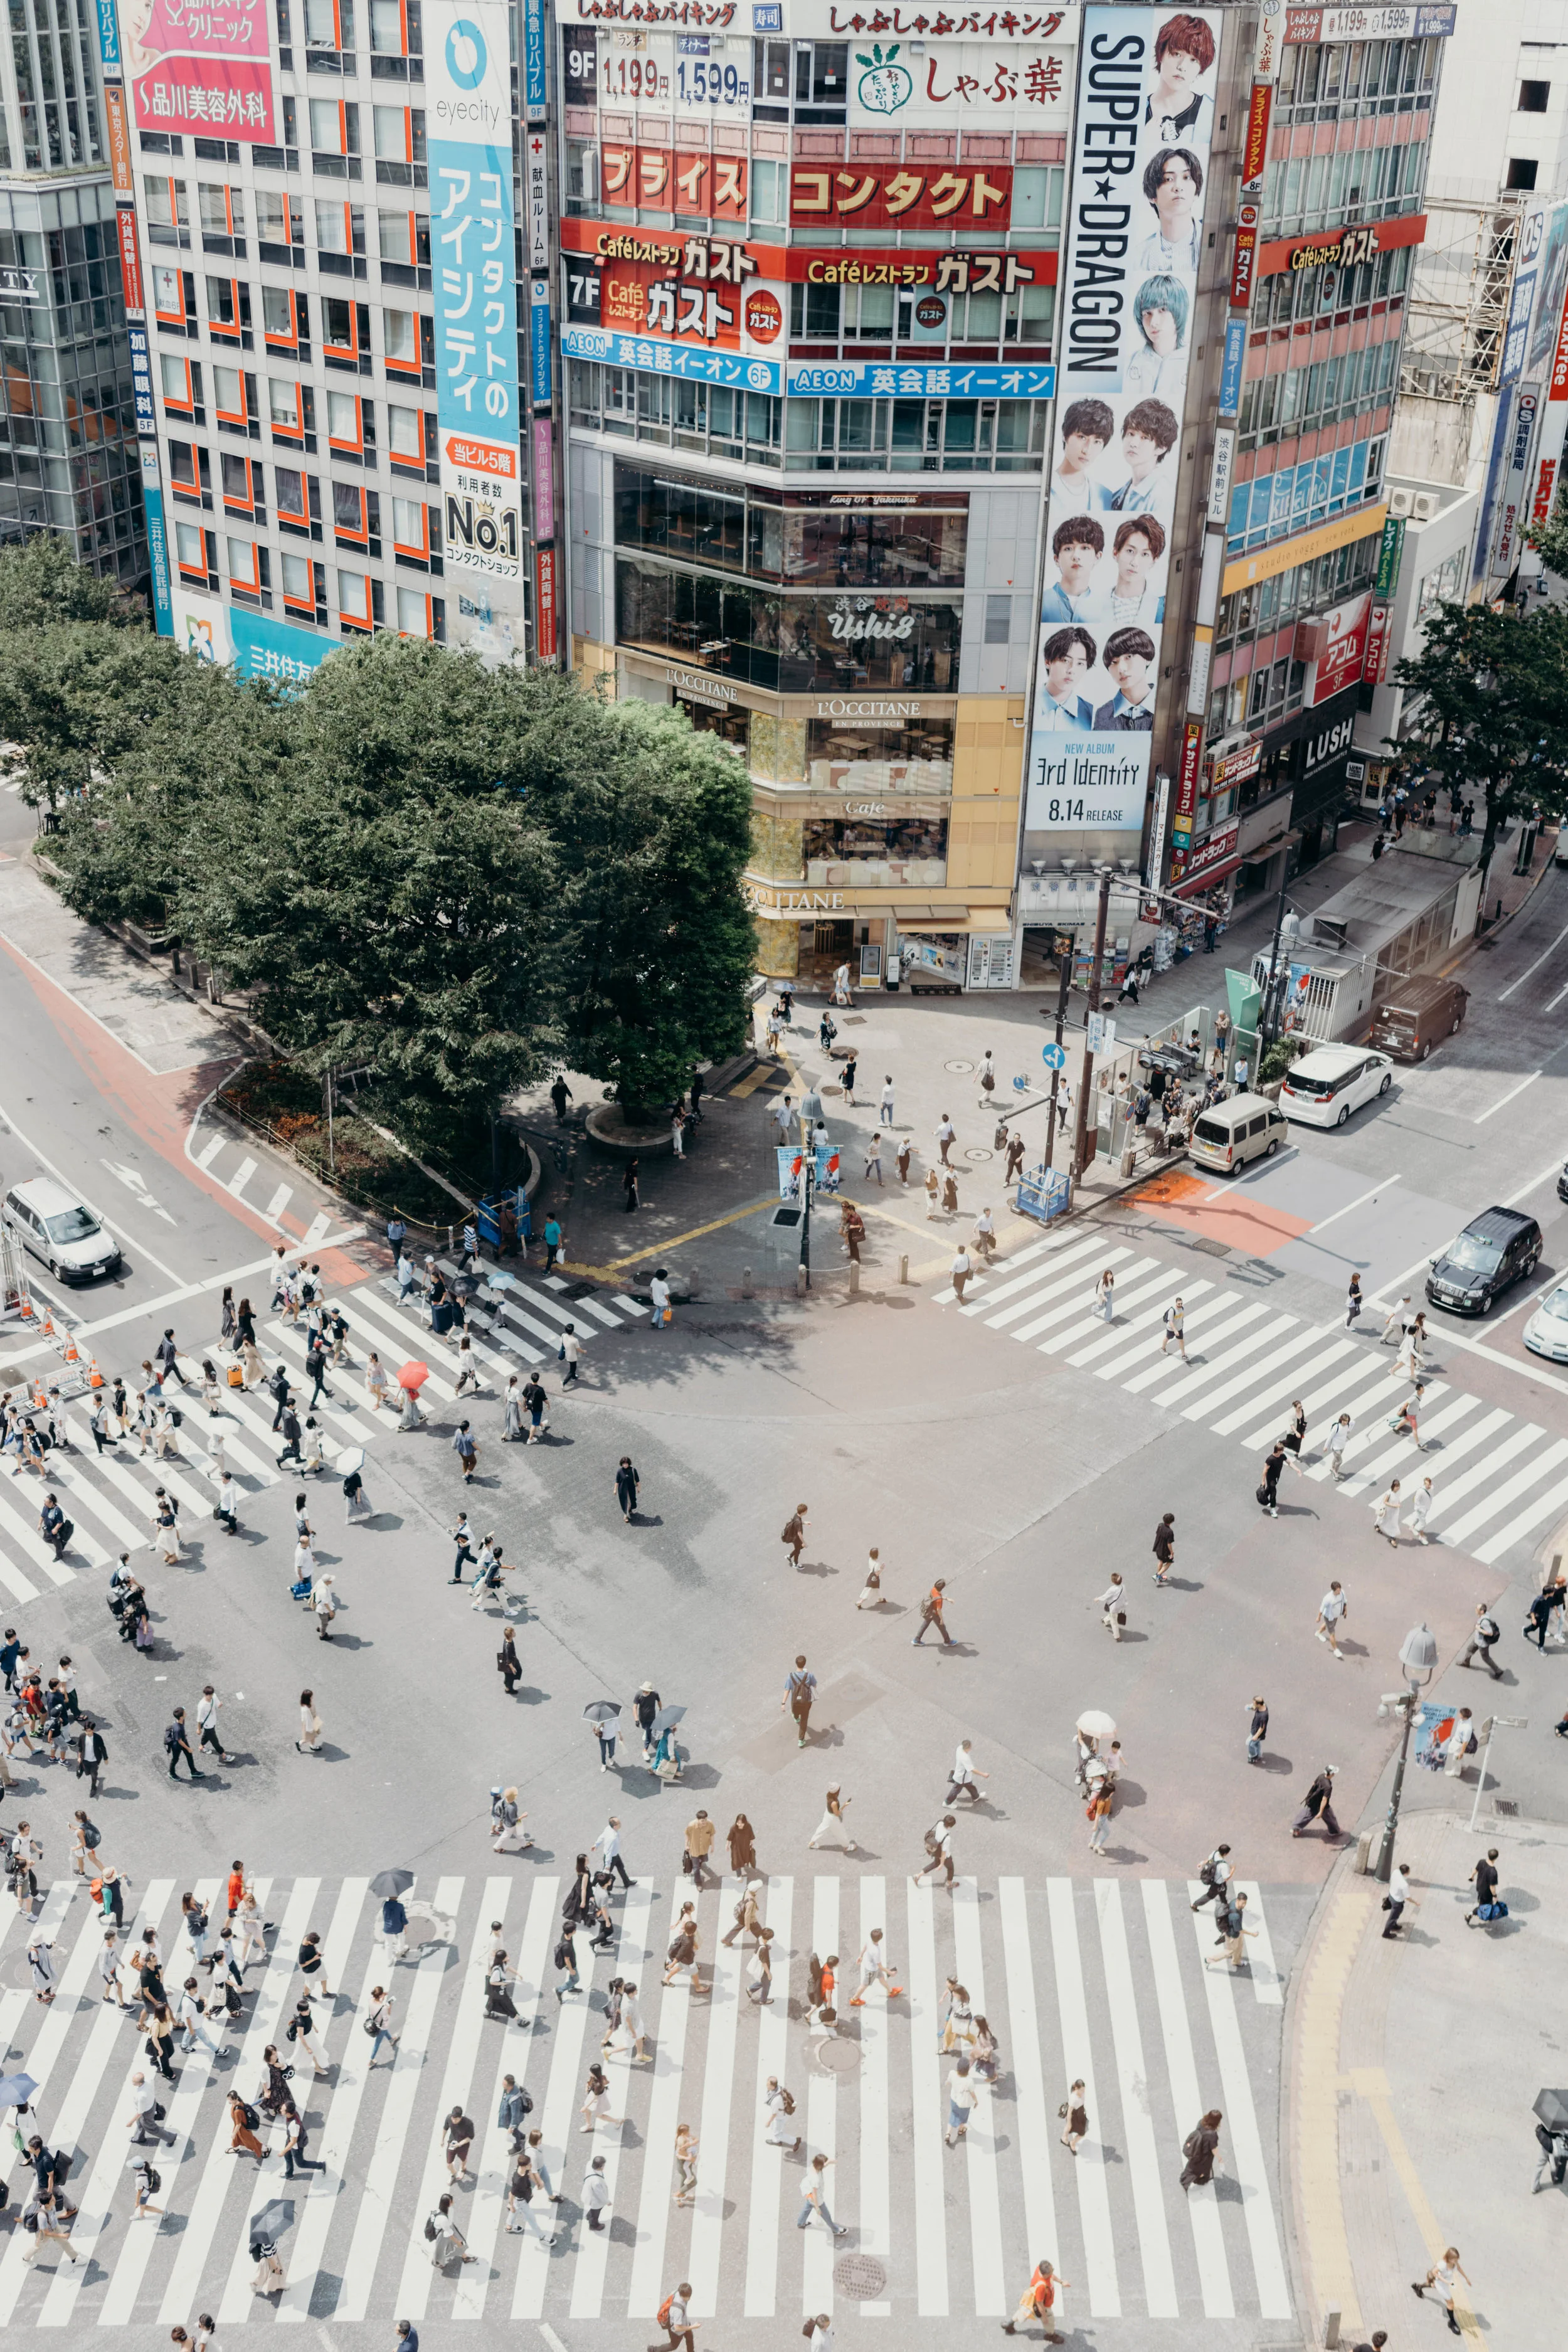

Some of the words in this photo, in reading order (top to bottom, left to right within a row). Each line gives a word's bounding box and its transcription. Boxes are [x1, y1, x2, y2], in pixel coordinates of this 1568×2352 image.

[188, 13, 252, 42] クリニック
[578, 0, 738, 27] しゃぶしゃぶバイキング
[755, 8, 778, 27] 寿司
[830, 6, 1066, 37] しゃぶしゃぶバイキング
[1290, 11, 1319, 26] しゃぶしゃぶ
[618, 34, 642, 48] ランチ
[679, 38, 709, 52] ディナー
[1259, 18, 1274, 72] しゃぶ葉
[1290, 25, 1316, 40] バイキング
[528, 0, 541, 99] 東急リバブル
[569, 50, 595, 78] 9F
[107, 65, 117, 74] 9F
[603, 57, 669, 100] 1,199円
[677, 61, 750, 106] 1,599円
[926, 55, 1063, 105] しゃぶ葉
[871, 74, 887, 109] たっぷり
[886, 69, 900, 105] おやさい
[152, 82, 267, 128] 品川美容外科
[437, 98, 500, 130] eyecity
[531, 107, 542, 118] 9F
[1082, 33, 1145, 176] SUPER
[1254, 87, 1267, 125] プライス
[111, 105, 127, 187] 東京スター銀行
[1249, 128, 1262, 176] コンタクト
[603, 151, 745, 206] プライス
[793, 172, 1004, 214] コンタクト
[1249, 181, 1261, 191] 8F
[532, 168, 544, 250] 献血ルーム
[121, 212, 135, 264] 外貨両替
[1239, 235, 1254, 243] Café
[1340, 229, 1379, 268] ガスト
[534, 257, 544, 265] 6F
[597, 233, 681, 265] Caféレストラン
[682, 238, 758, 284] ガスト
[808, 260, 929, 284] Caféレストラン
[935, 252, 1034, 294] ガスト
[1236, 249, 1252, 297] ガスト
[1292, 245, 1341, 270] Caféレストラン
[0, 272, 38, 290] TY
[438, 167, 478, 412] アイシティ
[480, 172, 509, 418] コンタクトの
[569, 274, 600, 305] 7F
[608, 280, 644, 305] Café
[1067, 204, 1130, 372] DRAGON
[608, 304, 644, 321] レストラン
[647, 282, 733, 339] ガスト
[750, 313, 779, 330] ガスト
[919, 310, 943, 319] ガスト
[130, 332, 152, 415] 加藤眼科
[568, 332, 605, 354] AEON
[619, 339, 741, 381] 英会話イーオン
[752, 366, 768, 385] 6F
[1224, 329, 1242, 407] 英会話イーオン
[797, 371, 854, 388] AEON
[871, 368, 1049, 395] 英会話イーオン
[139, 420, 152, 430] 5F
[454, 443, 511, 474] 当ビル5階
[1512, 424, 1530, 470] 調剤薬局
[457, 475, 502, 498] 利用者数
[539, 441, 550, 521] 品川美容外科
[1212, 437, 1229, 515] 渋谷駅前ビル
[830, 495, 850, 506] King
[445, 492, 519, 561] No.1
[539, 526, 551, 538] 4F
[1384, 521, 1396, 550] レイク
[1499, 504, 1516, 561] 処方せん受付
[151, 517, 169, 610] 三井住友信託銀行
[447, 548, 519, 577] コンタクトショップ
[1378, 551, 1391, 588] ALSA
[541, 553, 552, 609] 外貨両替
[827, 612, 915, 640] Ushi8
[250, 645, 317, 681] 三井住友
[1325, 635, 1357, 672] アコム
[1367, 638, 1380, 669] アコム
[665, 668, 738, 702] L'OCCITANE
[1333, 672, 1344, 690] 3F
[677, 691, 687, 699] EN
[689, 693, 727, 710] PROVENCE
[817, 699, 920, 716] L'OCCITANE
[852, 719, 901, 728] PROVENCE
[1189, 726, 1199, 736] 薬
[1065, 743, 1086, 755] NEW
[1088, 743, 1115, 755] ALBUM
[1306, 718, 1353, 768] LUSH
[1037, 758, 1066, 786] 3rd
[1181, 750, 1195, 809] サンドラッグ
[1224, 755, 1252, 778] サンドラッグ
[845, 802, 884, 818] Café
[1049, 799, 1083, 822] 8.14
[1086, 809, 1123, 821] RELEASE
